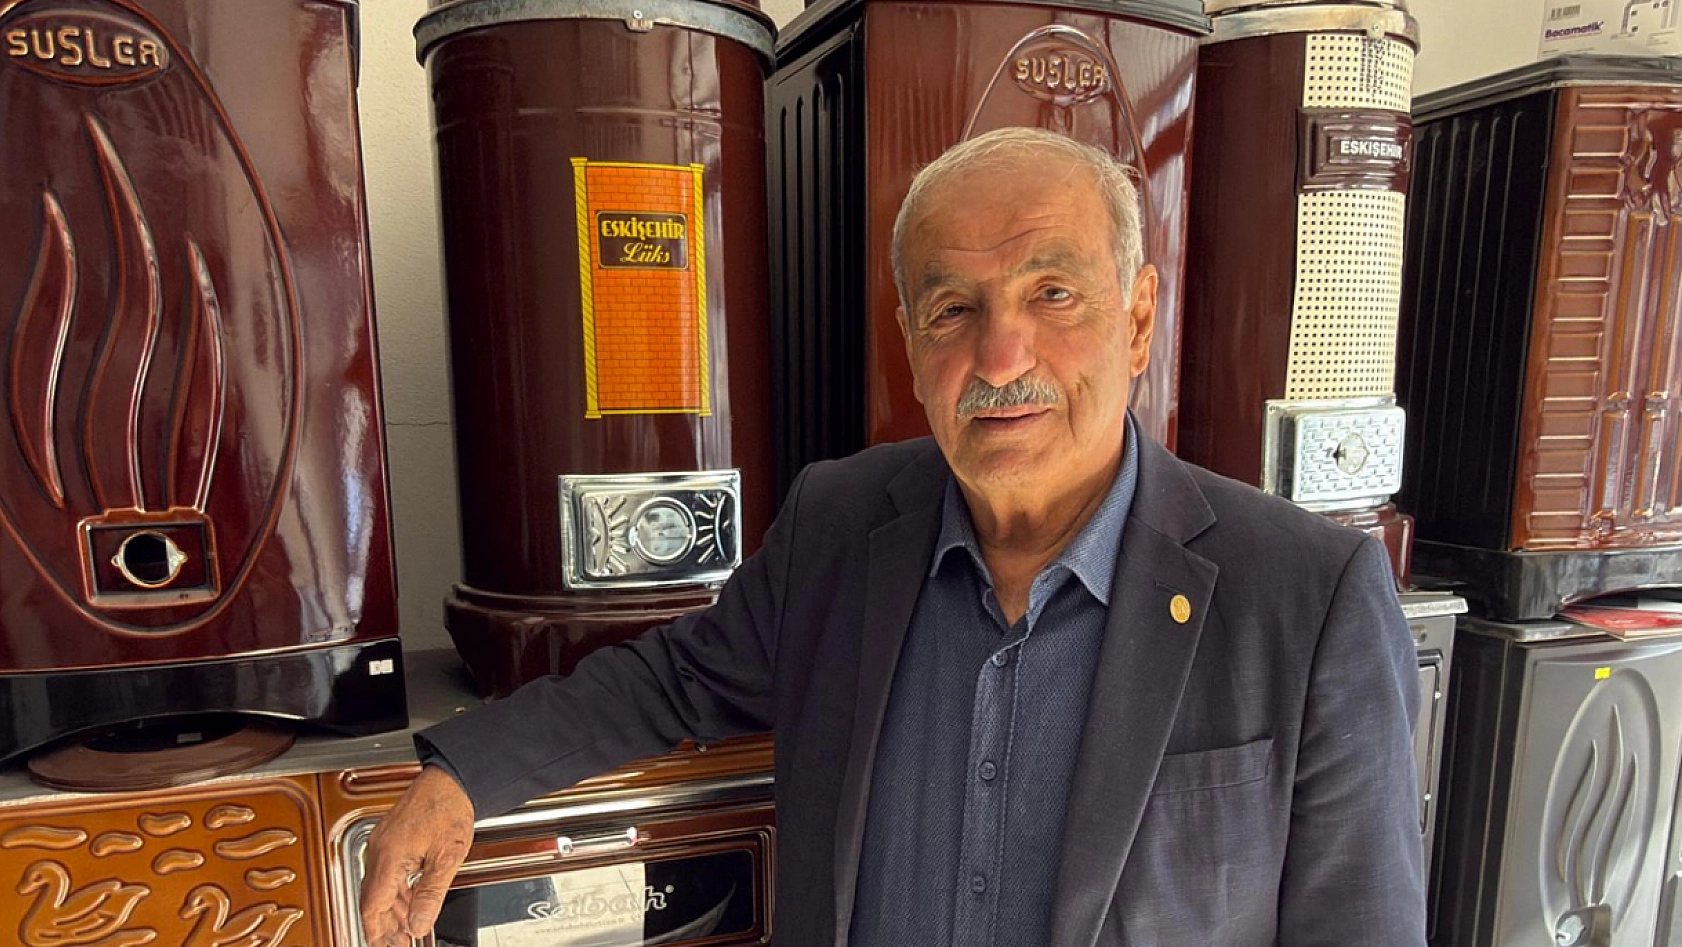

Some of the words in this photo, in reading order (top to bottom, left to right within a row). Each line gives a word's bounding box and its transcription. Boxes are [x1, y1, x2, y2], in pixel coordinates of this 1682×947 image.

[7, 27, 160, 68] SUSLER
[1017, 56, 1104, 88] SUSLER
[601, 217, 684, 240] ESKİŞEHİR
[620, 243, 670, 263] Lüks
